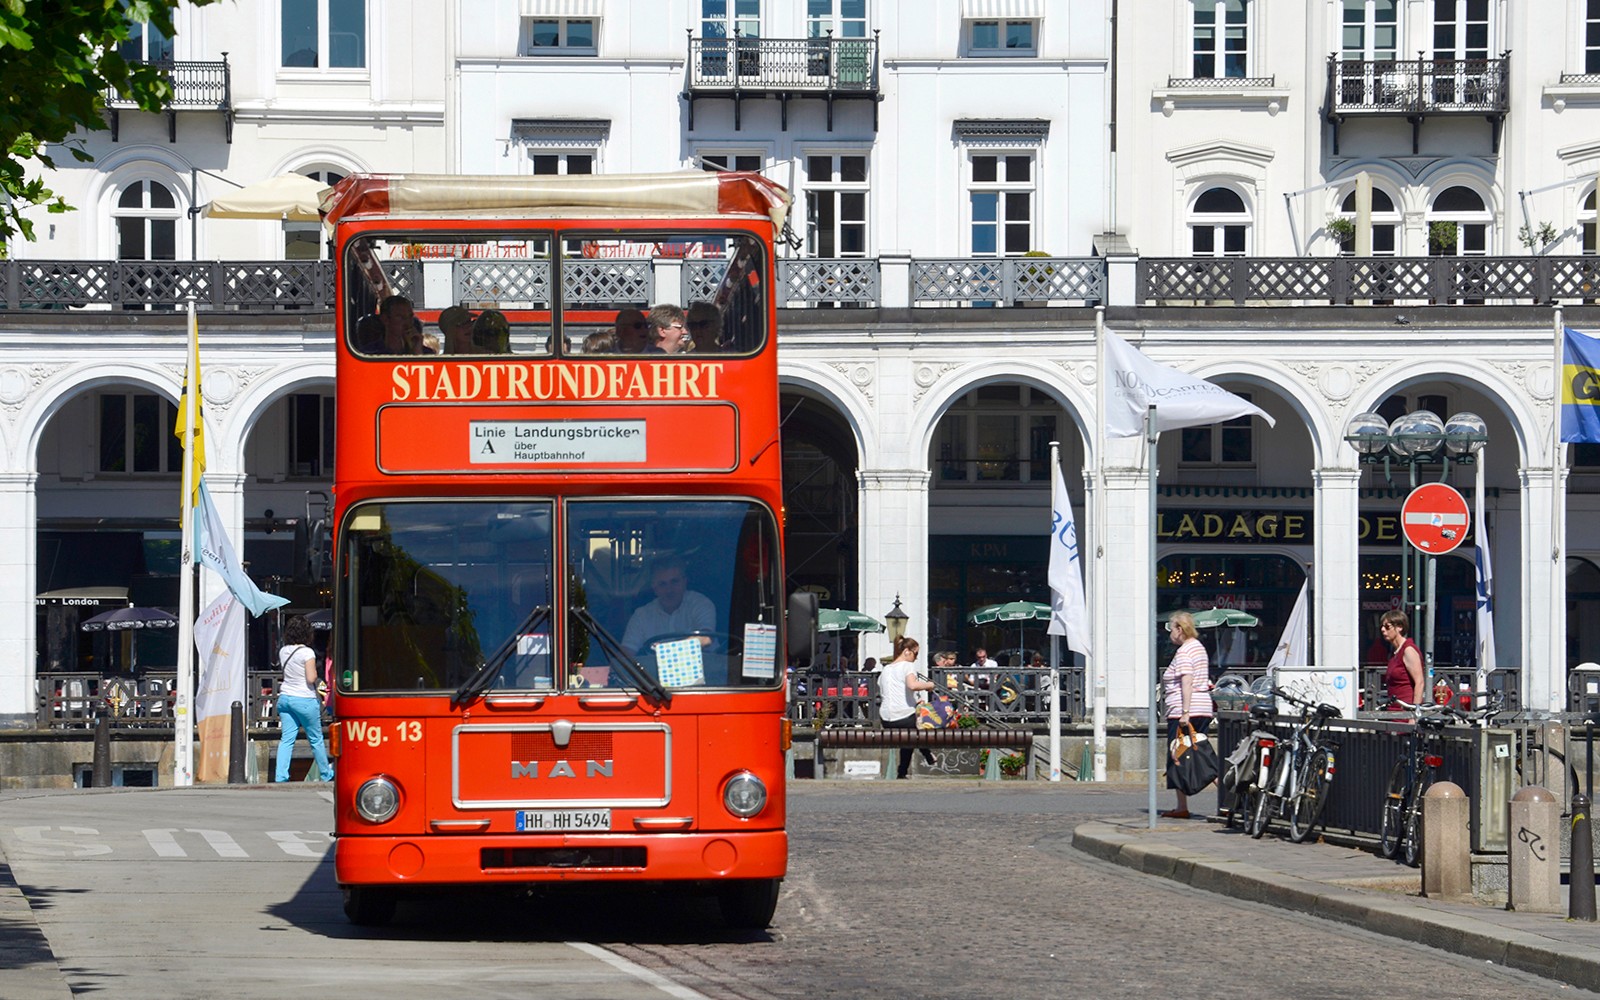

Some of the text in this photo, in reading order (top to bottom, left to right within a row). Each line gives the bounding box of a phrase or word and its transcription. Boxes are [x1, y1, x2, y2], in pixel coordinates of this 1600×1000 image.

[391, 363, 723, 401] STADTRUNDFAHRT
[475, 426, 640, 441] Linie Landungsbrücken
[481, 439, 496, 454] A
[514, 441, 537, 450] über
[514, 451, 586, 461] Hauptbahnhof
[1157, 513, 1305, 539] LADAGE
[970, 543, 1007, 557] KPM
[62, 597, 100, 606] London
[346, 721, 423, 748] Wg. 13
[511, 760, 613, 779] MAN
[525, 812, 609, 828] HH HH 5494
